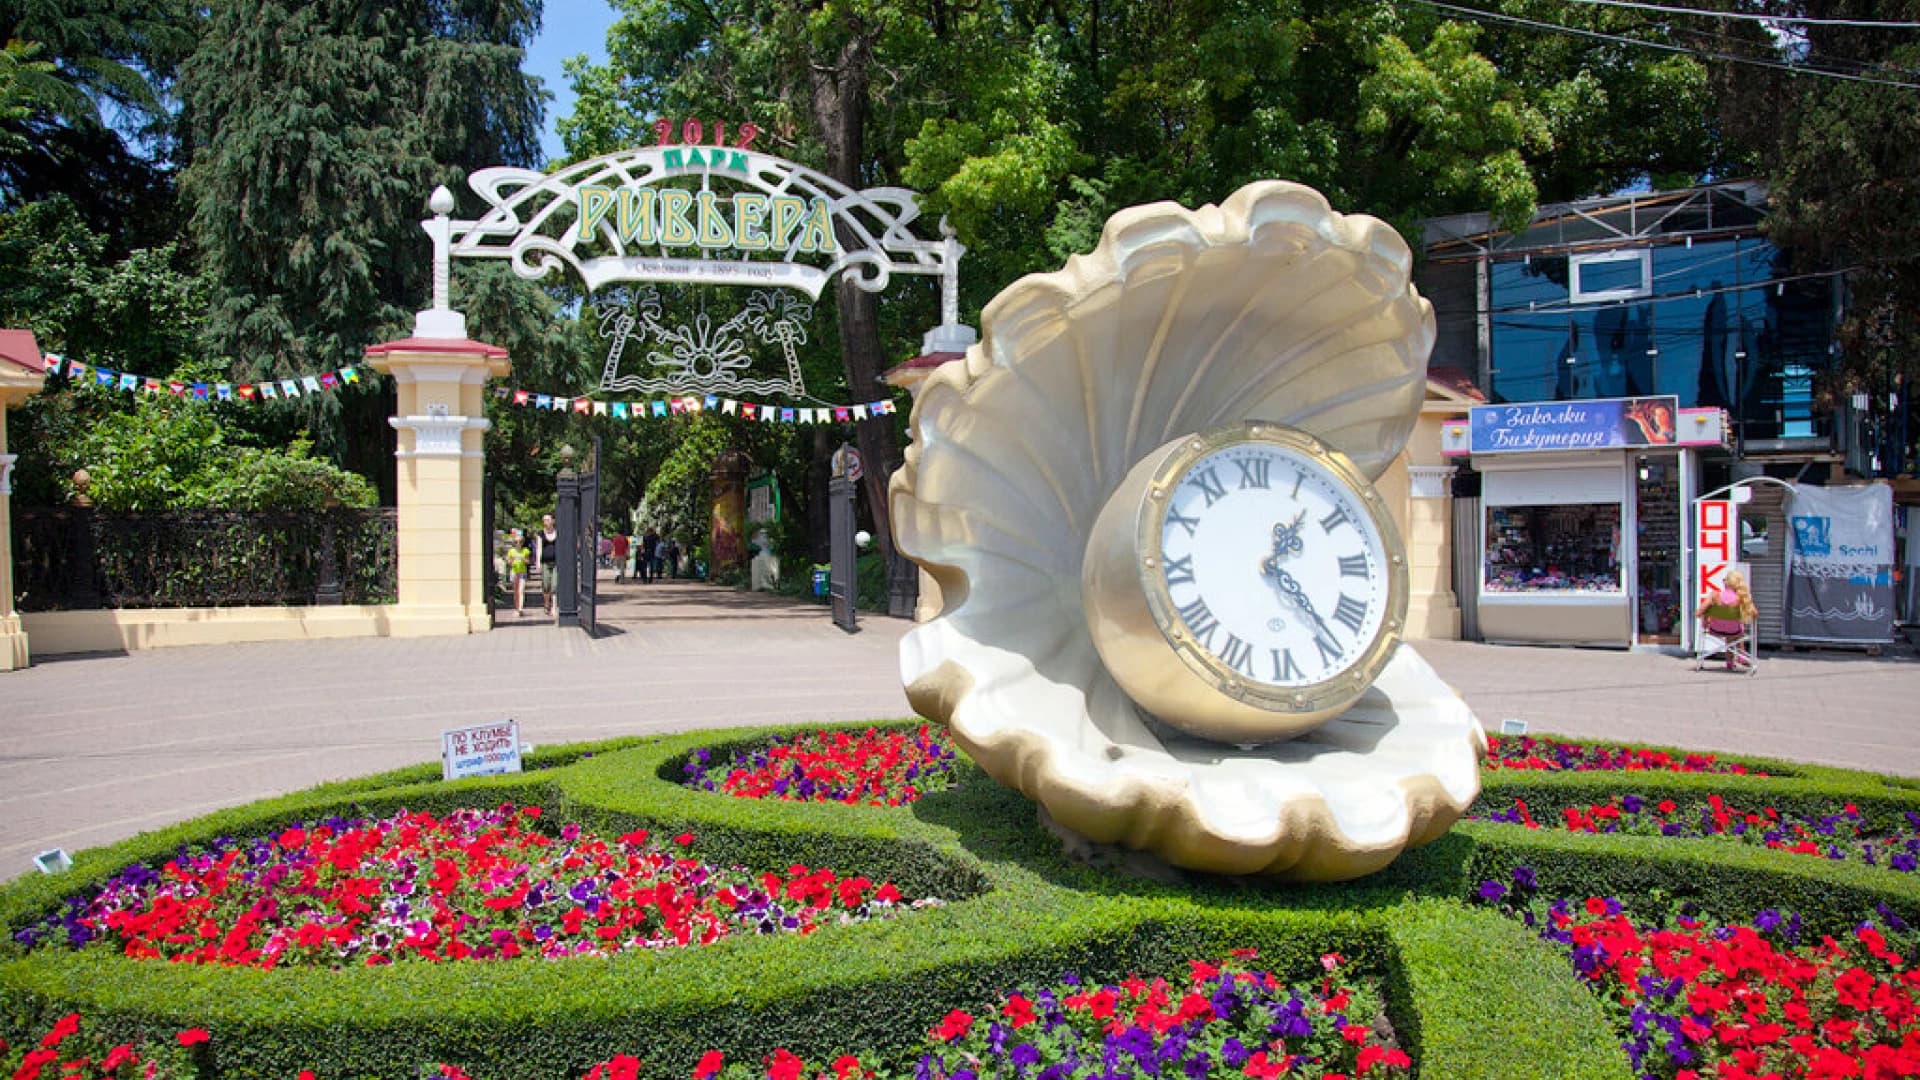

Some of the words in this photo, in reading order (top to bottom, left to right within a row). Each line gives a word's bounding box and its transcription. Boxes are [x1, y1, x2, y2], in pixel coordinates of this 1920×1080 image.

[653, 117, 758, 151] 2012
[663, 147, 749, 173] ПАРК
[577, 186, 839, 252] РИВЬЕРА
[1505, 405, 1587, 427] Заколки
[1490, 428, 1604, 449] Бижутерия
[1187, 466, 1228, 508] XI
[1232, 458, 1272, 489] XII
[1290, 471, 1307, 500] I
[1319, 504, 1350, 535] II
[1163, 552, 1195, 586] IX
[1337, 551, 1369, 580] III
[1701, 501, 1728, 606] ОЧК
[1176, 595, 1220, 650] VIII
[1219, 631, 1256, 677] VII
[1270, 648, 1306, 681] VI
[1313, 634, 1344, 669] V
[455, 743, 468, 756] НЕ
